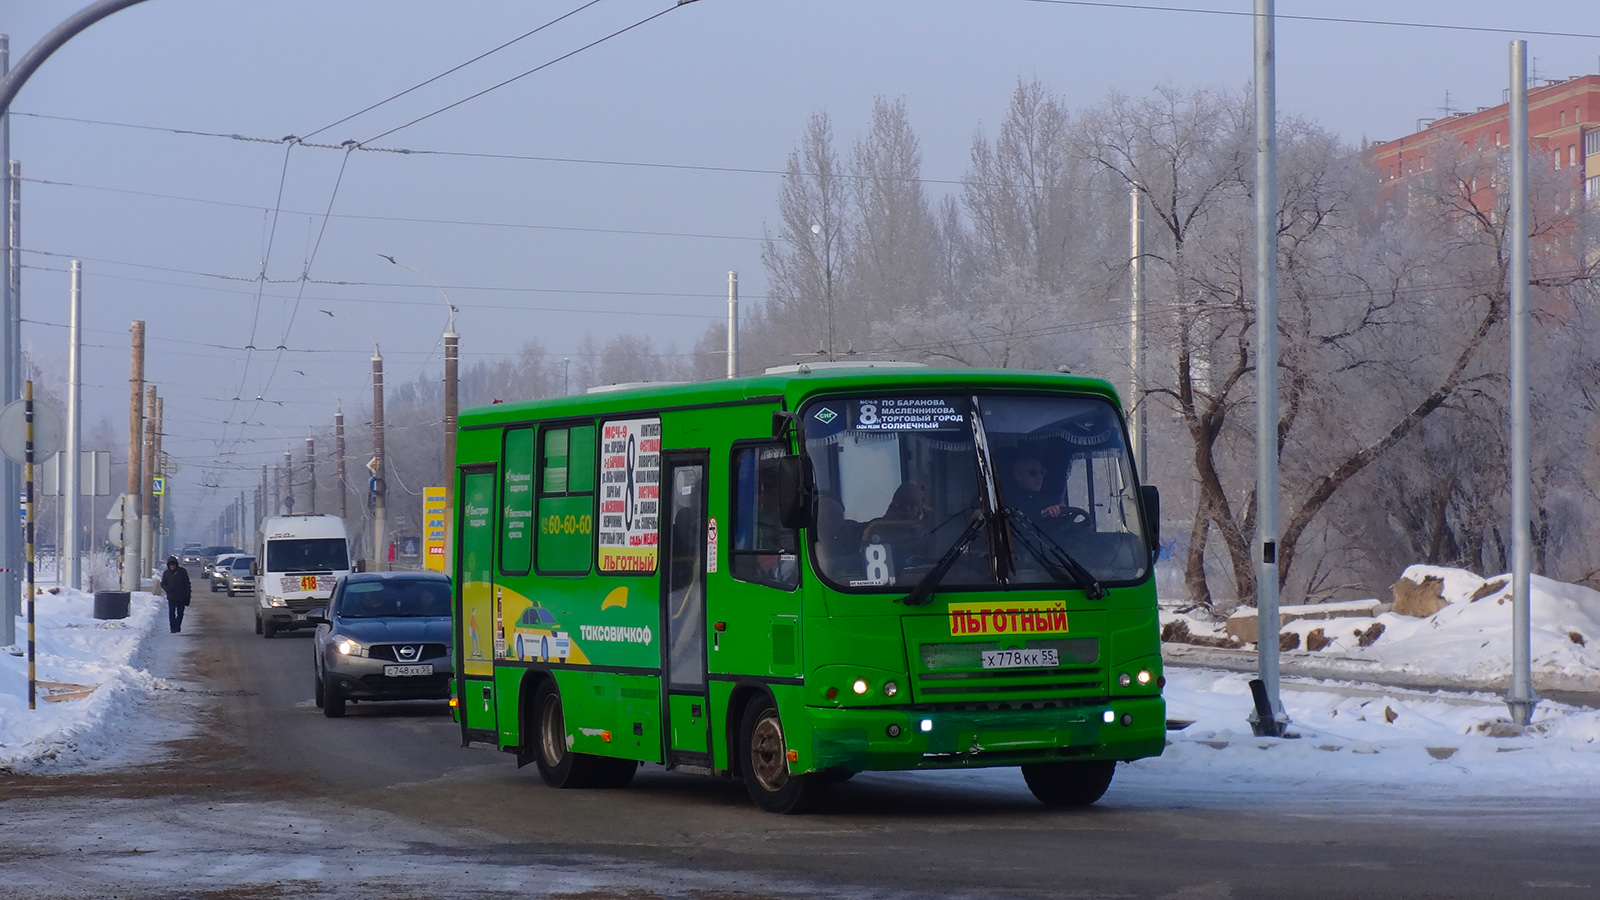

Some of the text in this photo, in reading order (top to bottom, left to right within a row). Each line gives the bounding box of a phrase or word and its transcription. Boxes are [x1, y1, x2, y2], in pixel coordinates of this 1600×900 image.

[860, 405, 877, 424] 8
[881, 414, 963, 422] ТОРГОВЫЙ ГОРОД
[604, 425, 627, 439] МСЧ-9
[881, 422, 939, 430] СОЛНЕЧНЫЙ
[625, 433, 635, 531] 8
[549, 515, 591, 535] 60-60-60
[603, 553, 654, 571] ЛЬГОТНЫЙ
[866, 544, 889, 584] 8
[301, 576, 317, 590] 418
[952, 602, 1067, 633] ЛЬГОТНЫЙ
[1042, 651, 1053, 661] 55
